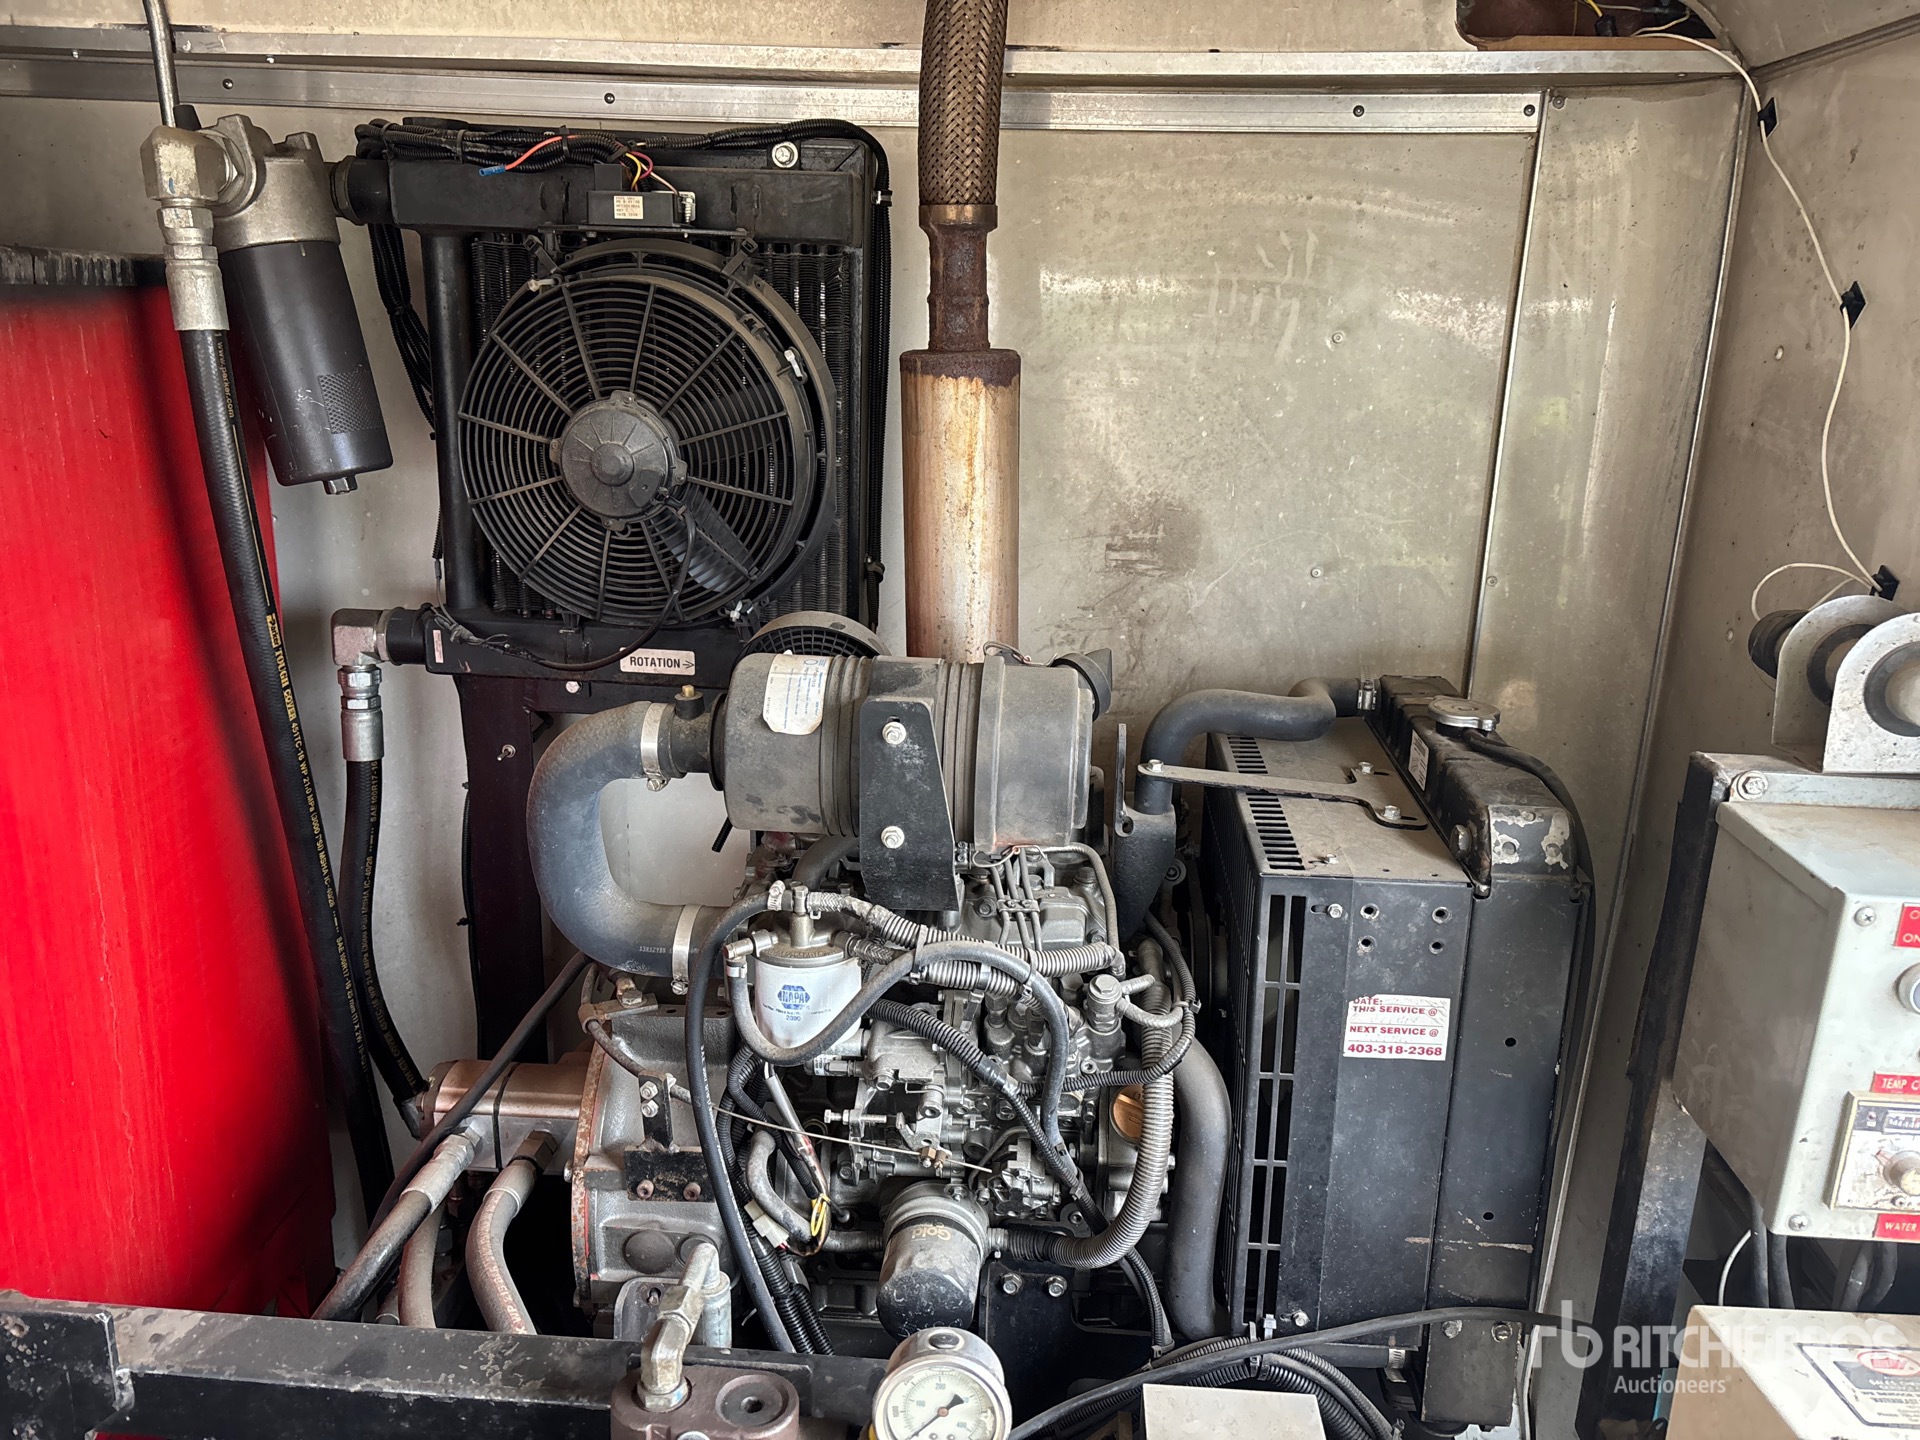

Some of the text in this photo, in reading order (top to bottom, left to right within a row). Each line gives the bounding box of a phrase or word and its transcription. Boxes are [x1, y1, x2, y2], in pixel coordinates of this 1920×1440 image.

[217, 341, 235, 418] www.parker.com
[267, 616, 281, 648] Parker
[275, 648, 289, 688] TOUGH
[629, 656, 682, 670] ROTATION
[283, 688, 297, 721] COVER
[300, 762, 308, 776] WP
[307, 794, 316, 812] MPa
[310, 812, 321, 834] (3000
[319, 851, 330, 876] MSHA
[782, 991, 805, 1004] NAPA
[1353, 998, 1383, 1006] DATE:
[1353, 1005, 1438, 1016] THIS SERVICE @
[1380, 1027, 1426, 1035] SERVICE
[1429, 1029, 1439, 1037] @
[1347, 1044, 1443, 1056] 403-318-2368
[1881, 1078, 1908, 1089] TEMP
[1885, 1221, 1918, 1232] WATER
[912, 1227, 952, 1241] Gold
[507, 1305, 522, 1324] WP
